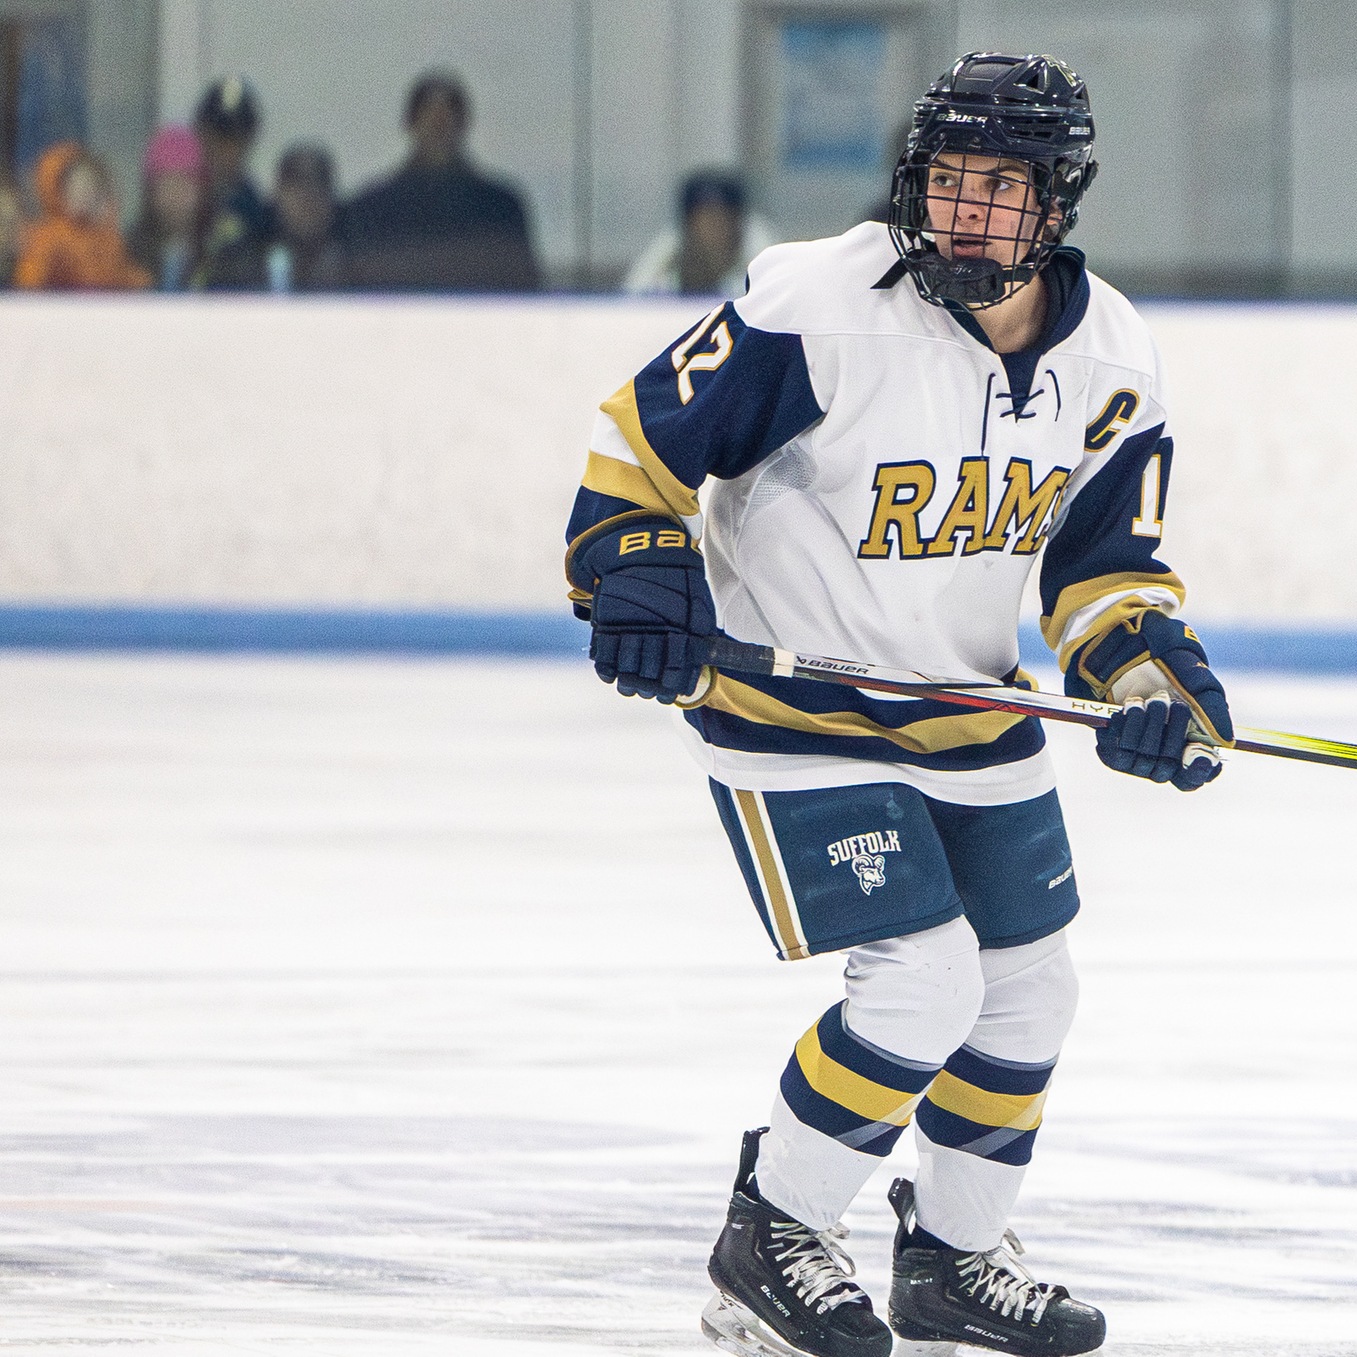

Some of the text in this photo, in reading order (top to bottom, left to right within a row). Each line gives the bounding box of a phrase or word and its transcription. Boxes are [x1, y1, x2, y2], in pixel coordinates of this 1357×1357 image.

[671, 302, 733, 406] 12
[1084, 388, 1140, 452] C
[857, 455, 1071, 560] RAM
[1131, 453, 1163, 538] 1
[827, 830, 902, 867] SUFFOLK
